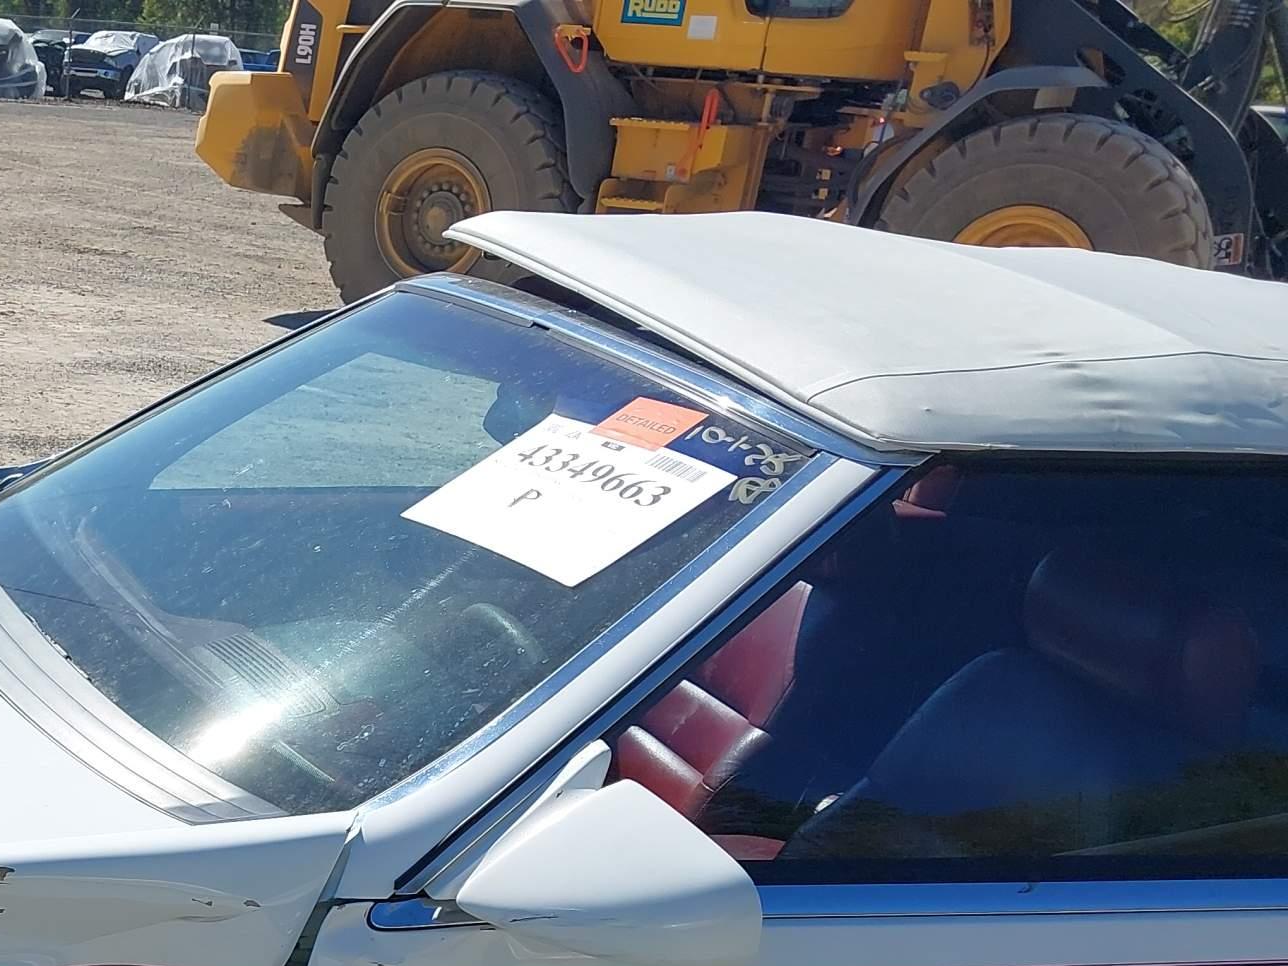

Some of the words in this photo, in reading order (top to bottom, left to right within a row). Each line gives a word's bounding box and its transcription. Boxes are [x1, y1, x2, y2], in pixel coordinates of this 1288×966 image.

[295, 24, 316, 64] L90H
[615, 414, 677, 435] DETAILED
[517, 444, 672, 507] 43349663
